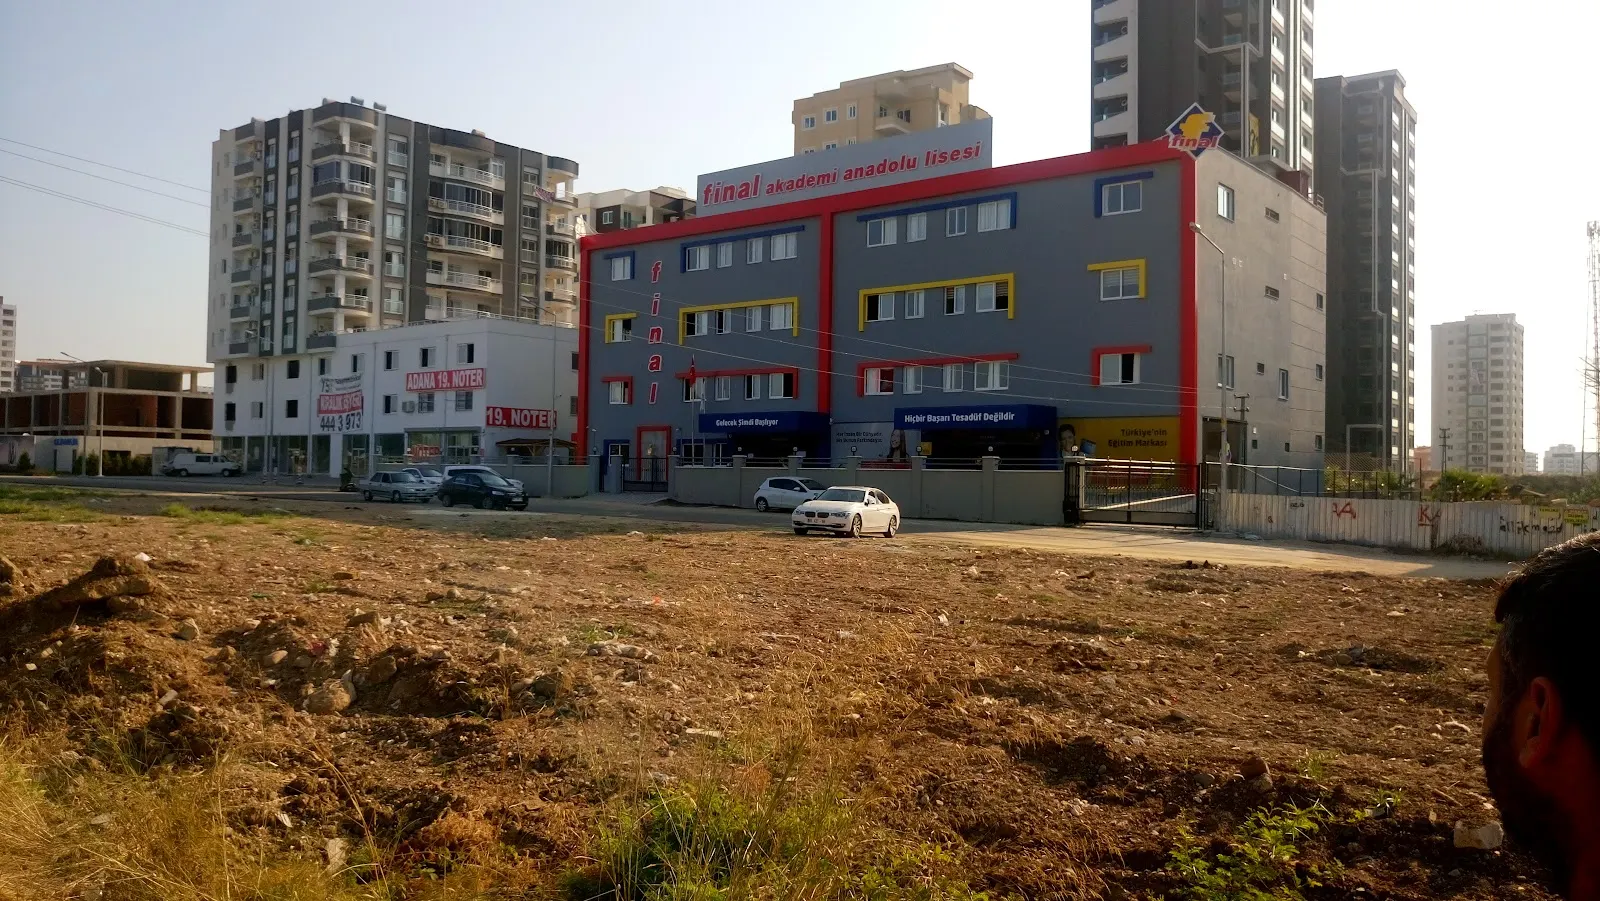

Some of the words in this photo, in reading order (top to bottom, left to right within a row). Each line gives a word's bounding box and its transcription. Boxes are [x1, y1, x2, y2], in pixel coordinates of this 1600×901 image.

[1169, 134, 1219, 150] final
[702, 174, 761, 206] final
[765, 168, 838, 195] akademi
[843, 154, 918, 181] anadolu
[923, 140, 983, 168] lisesi
[648, 260, 663, 405] final
[407, 372, 435, 390] ADANA
[437, 371, 450, 388] 19.
[453, 369, 483, 387] NOTER
[320, 416, 335, 431] 444
[338, 414, 344, 431] 3
[346, 412, 361, 430] 973
[486, 407, 507, 425] 19.
[511, 408, 556, 427] NOTER
[715, 419, 737, 427] Gelecek
[738, 418, 754, 427] Şimdi
[904, 414, 926, 424] Hiçbir
[927, 414, 950, 423] Başarı
[951, 413, 982, 422] Tesadüf
[983, 411, 1015, 422] Değildir
[1121, 428, 1168, 437] Türkiye'nin
[1108, 439, 1133, 448] Eğitim
[1135, 439, 1168, 447] Markası
